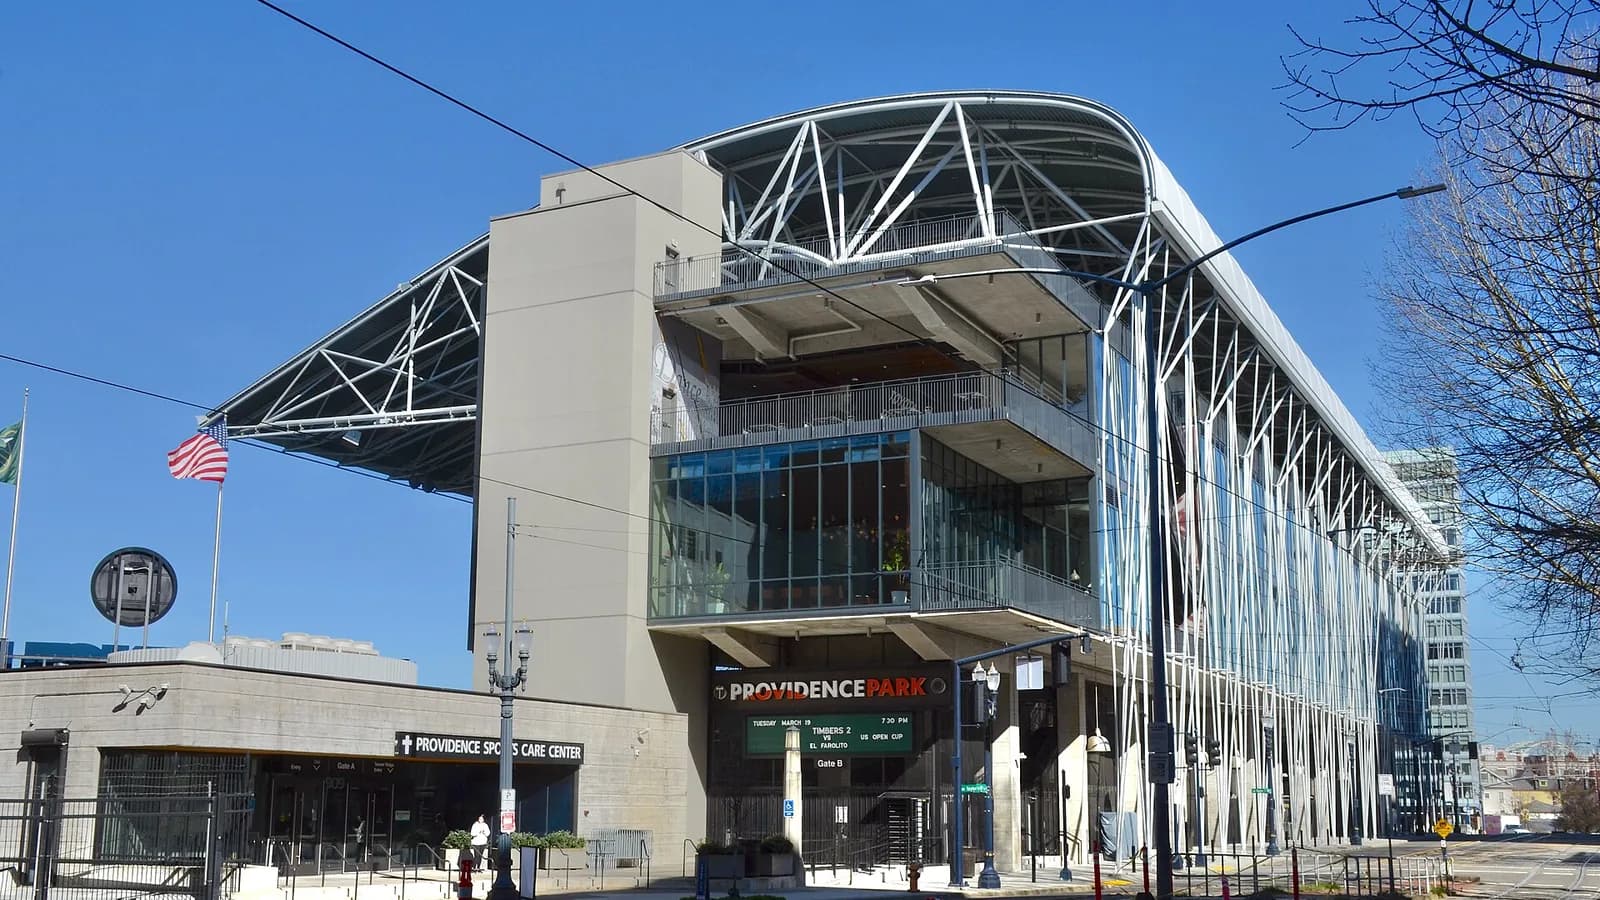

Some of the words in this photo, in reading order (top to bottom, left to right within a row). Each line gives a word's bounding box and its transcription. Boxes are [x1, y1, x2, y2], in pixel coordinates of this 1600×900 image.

[752, 719, 777, 727] TUESDAY
[781, 719, 802, 727] MARCH
[881, 716, 896, 724] 730
[898, 716, 909, 724] PM
[812, 726, 845, 735] TIMBERS
[846, 726, 852, 734] 2
[415, 737, 481, 755] PROVIDENCE
[483, 741, 519, 756] SPOS
[521, 743, 546, 758] CARE
[548, 745, 582, 760] CENTER
[809, 742, 818, 750] EL
[820, 742, 848, 750] FAROLITO
[336, 762, 350, 770] Gate
[350, 762, 356, 770] A
[817, 758, 836, 768] Gate
[837, 758, 843, 768] B
